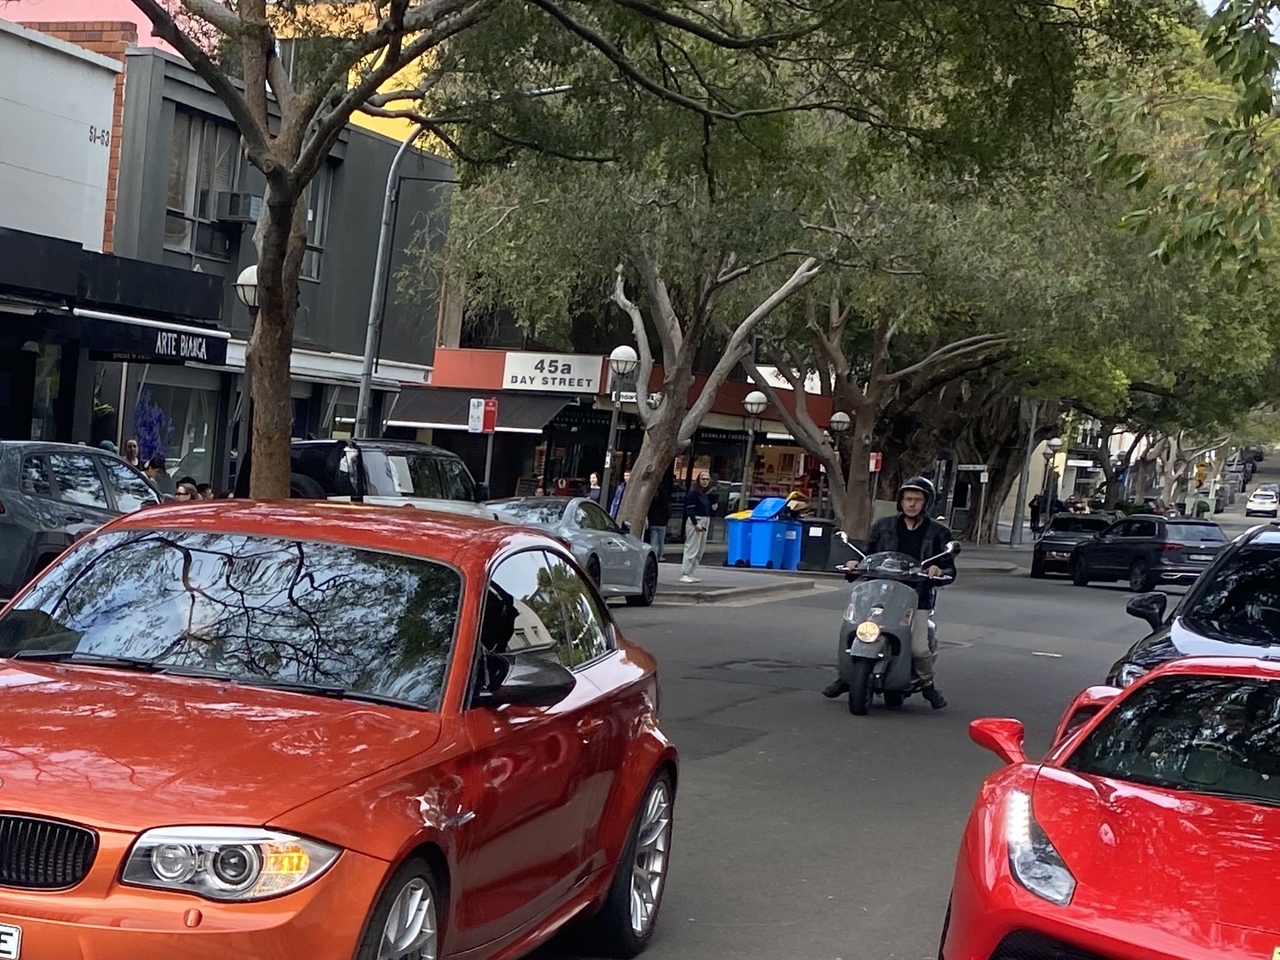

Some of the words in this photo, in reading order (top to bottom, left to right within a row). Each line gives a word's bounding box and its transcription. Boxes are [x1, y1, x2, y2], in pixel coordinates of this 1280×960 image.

[88, 125, 110, 147] 51-53
[155, 331, 177, 355] ARTE
[180, 334, 207, 360] BIANCA
[534, 359, 572, 374] 45a
[511, 375, 535, 385] BAY
[542, 376, 593, 387] STREET
